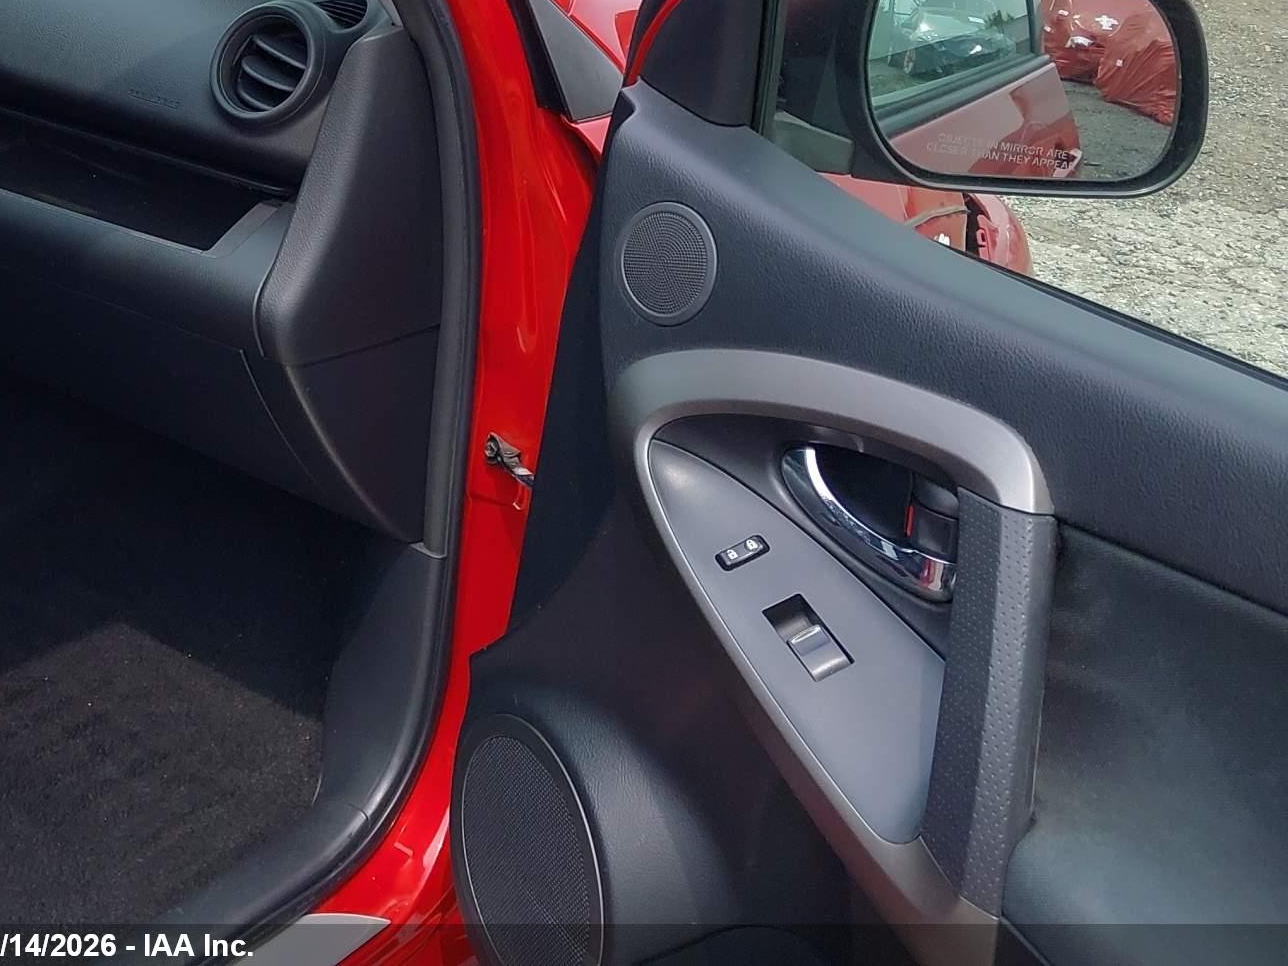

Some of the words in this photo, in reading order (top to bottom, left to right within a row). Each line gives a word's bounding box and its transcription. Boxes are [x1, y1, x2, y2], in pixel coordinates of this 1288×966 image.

[926, 141, 969, 155] CLOSER
[1003, 152, 1031, 165] THEY
[987, 138, 999, 150] IN
[1000, 141, 1044, 156] MIRROR
[1046, 148, 1069, 160] ARE
